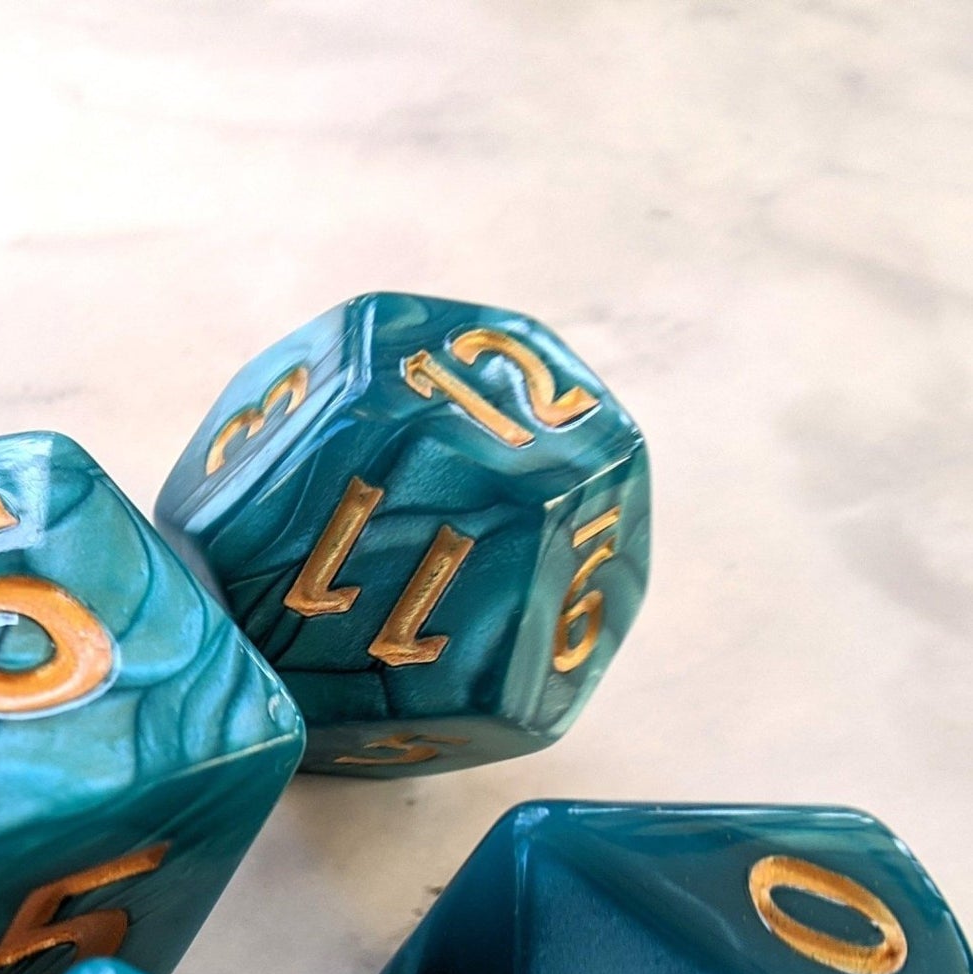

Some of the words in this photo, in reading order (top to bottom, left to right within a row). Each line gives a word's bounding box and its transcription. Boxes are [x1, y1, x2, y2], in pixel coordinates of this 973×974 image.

[205, 366, 309, 476] 3
[401, 328, 601, 448] 12
[283, 475, 475, 667] 11
[333, 730, 472, 765] 5
